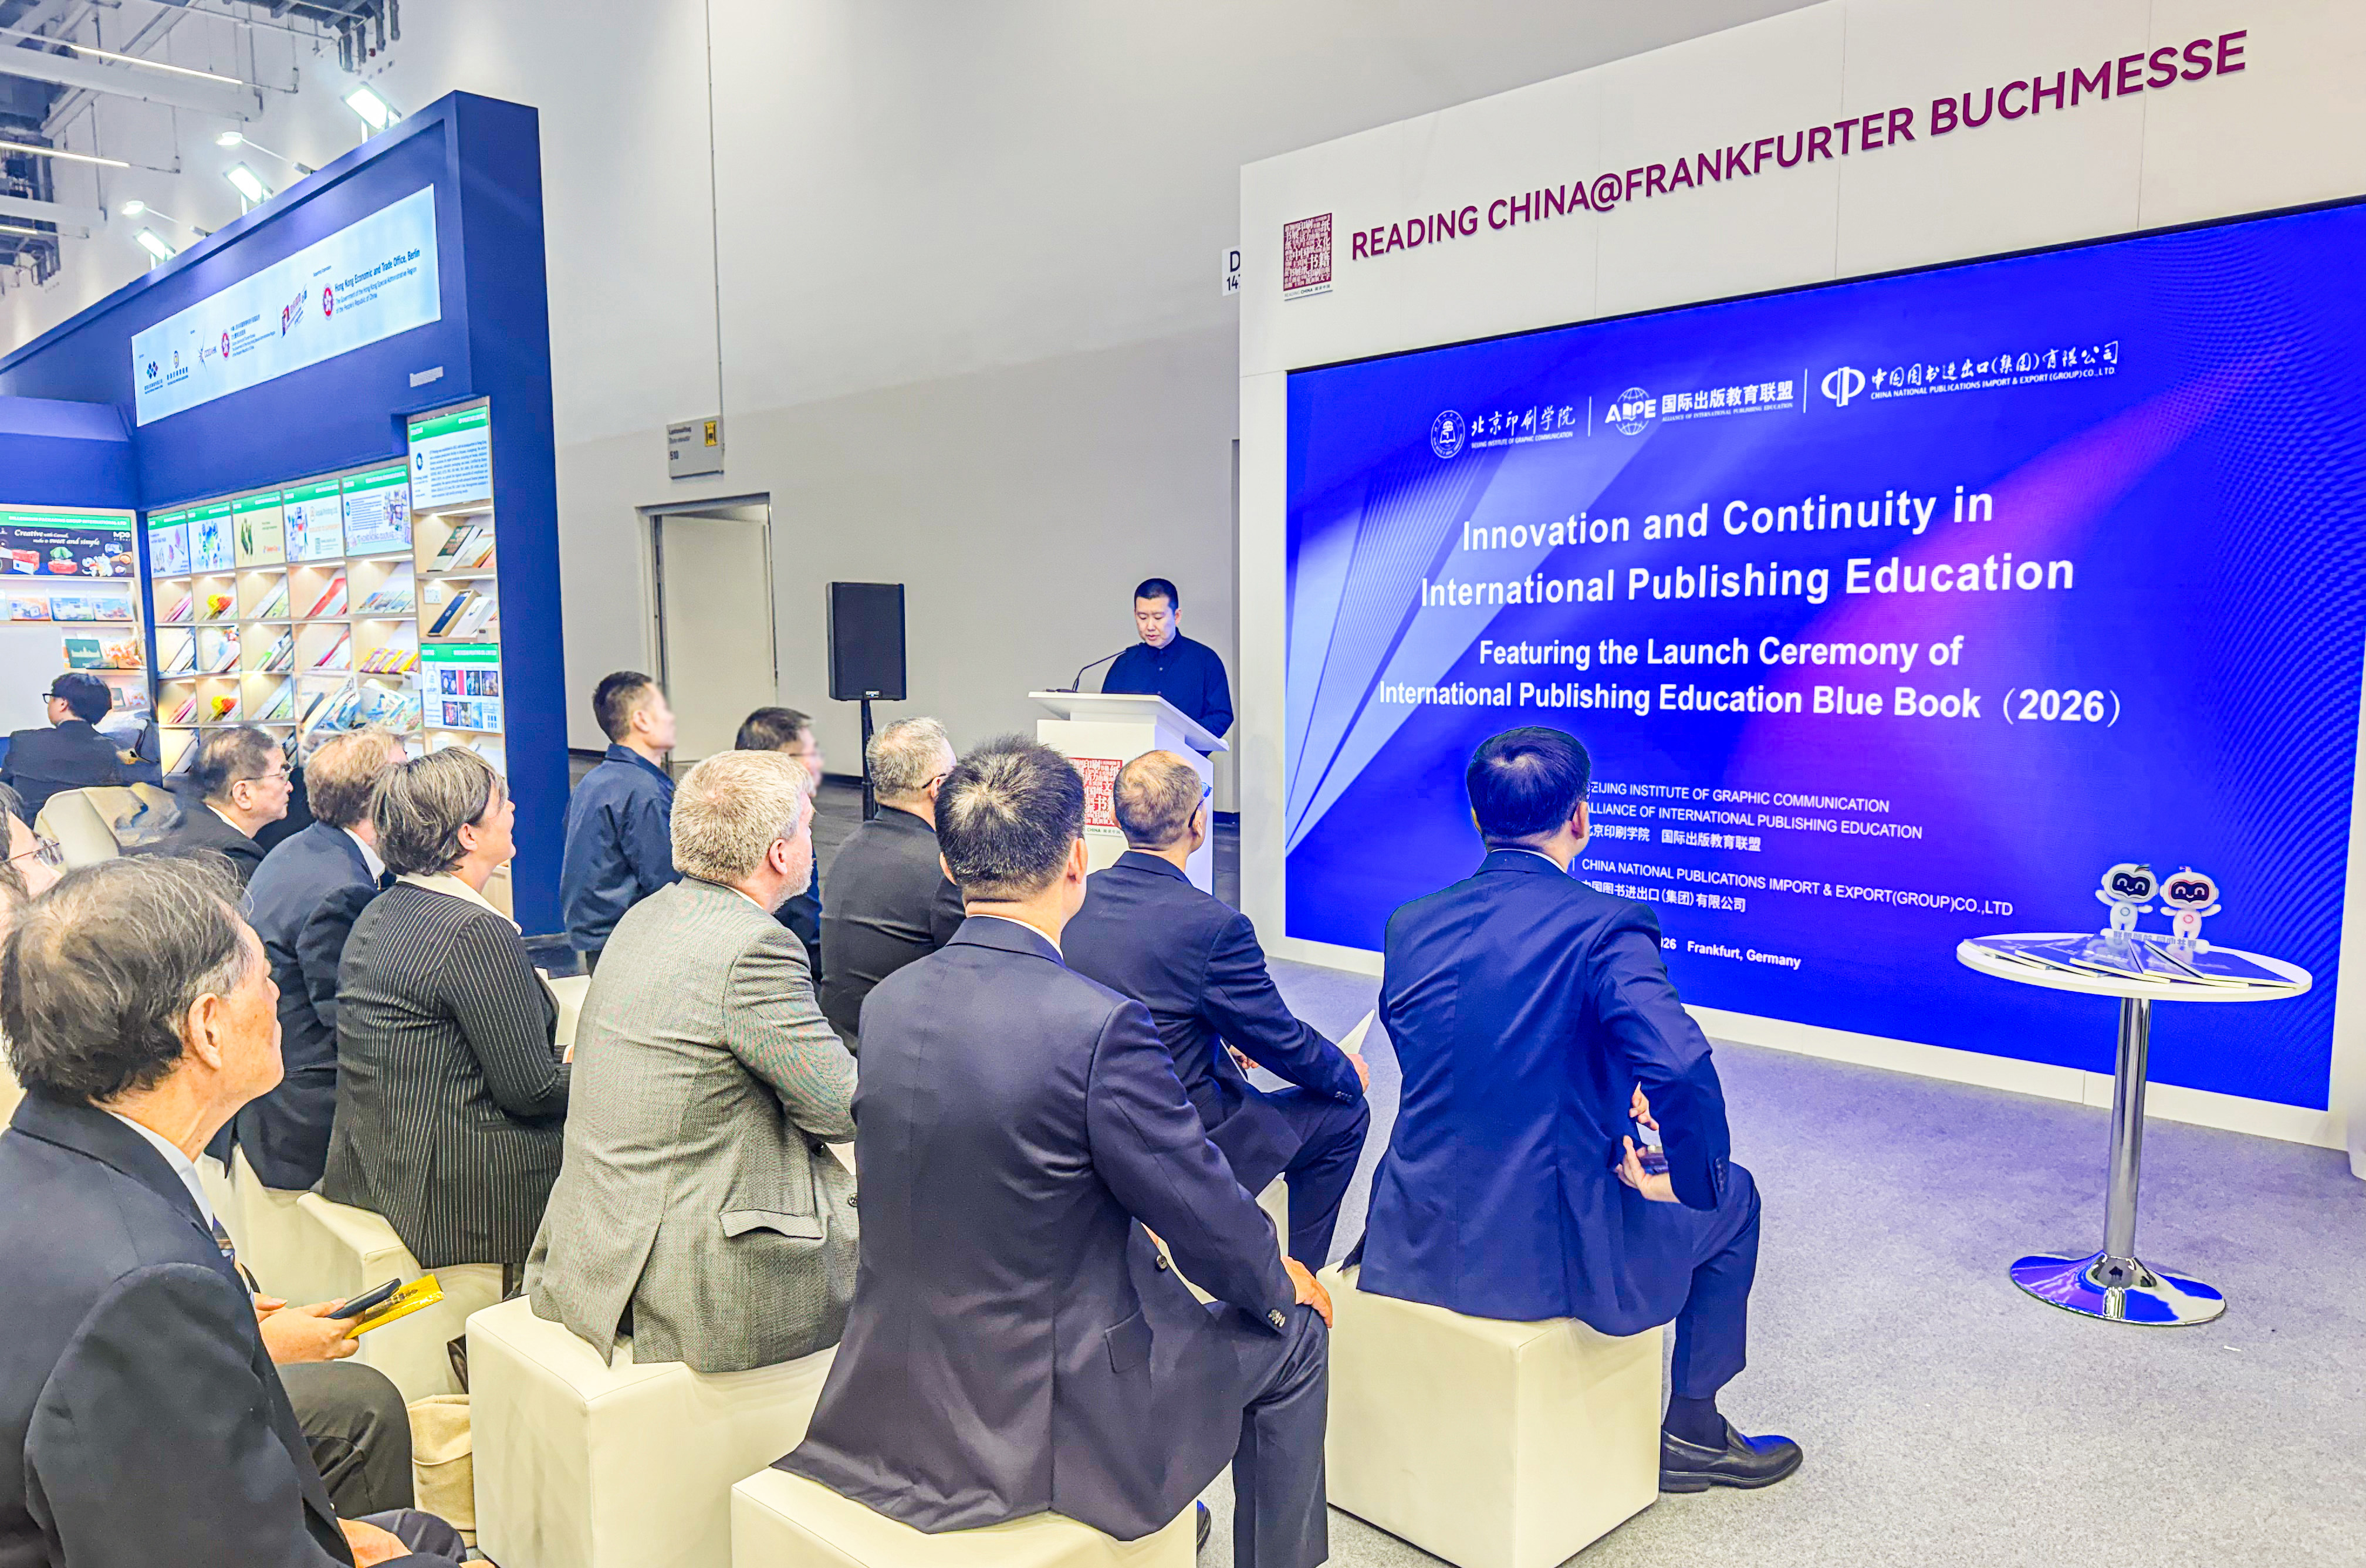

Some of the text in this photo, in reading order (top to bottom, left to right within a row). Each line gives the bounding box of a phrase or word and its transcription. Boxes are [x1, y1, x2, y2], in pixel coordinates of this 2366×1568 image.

[1352, 29, 2247, 260] READING CHINA@FRANKFURTER BUCHMESSE
[1230, 250, 1240, 272] D
[1293, 246, 1309, 261] 中国
[334, 283, 344, 292] Hong
[344, 278, 354, 288] Kong
[354, 268, 372, 283] Economic
[381, 259, 392, 271] Trade
[393, 255, 407, 266] Office,
[407, 248, 420, 261] Berlin
[1226, 273, 1240, 291] 14
[1661, 380, 1794, 415] 国际出版教育联盟
[1870, 390, 1892, 400] CHINA
[1893, 387, 1927, 398] NATIONAL
[1929, 381, 1980, 394] PUBLICATIONS
[1982, 377, 2010, 388] IMPORT
[2012, 376, 2017, 385] &
[2020, 373, 2047, 384] EXPORT
[1471, 404, 1576, 437] 北京印刷学院
[1471, 441, 1487, 449] BEIJING
[1488, 438, 1508, 447] INSTITUTE
[1515, 435, 1534, 444] GRAPHIC
[1535, 431, 1573, 442] COMMUNICATION
[14, 529, 43, 537] Creative
[1463, 486, 1993, 551] Innovation and Continuity in
[80, 538, 100, 548] simple
[1421, 552, 2074, 607] International Publishing Education
[1479, 634, 1965, 673] Featuring the Launch Ceremony of
[1380, 680, 1512, 707] International
[1519, 682, 1650, 716] Publishing
[1659, 684, 1802, 714] Education
[1813, 685, 1883, 715] Blue
[1894, 686, 1982, 718] Book
[1590, 781, 1890, 813] EIJING INSTITUTE OF GRAPHIC COMMUNICATION
[1640, 805, 1655, 818] OF
[1658, 807, 1755, 826] INTERNATIONAL
[1757, 813, 1837, 833] PUBLISHING
[1841, 820, 1923, 840] EDUCATION
[1661, 829, 1761, 851] 国际出版教育联盟
[1581, 858, 1617, 873] CHINA
[1618, 862, 1674, 880] NATIONAL
[1677, 868, 1766, 890] PUBLICATIONS
[1769, 878, 1821, 895] IMPORT
[1823, 883, 1832, 897] &
[1687, 940, 1743, 961] Frankfurt,
[1746, 948, 1801, 971] Germany
